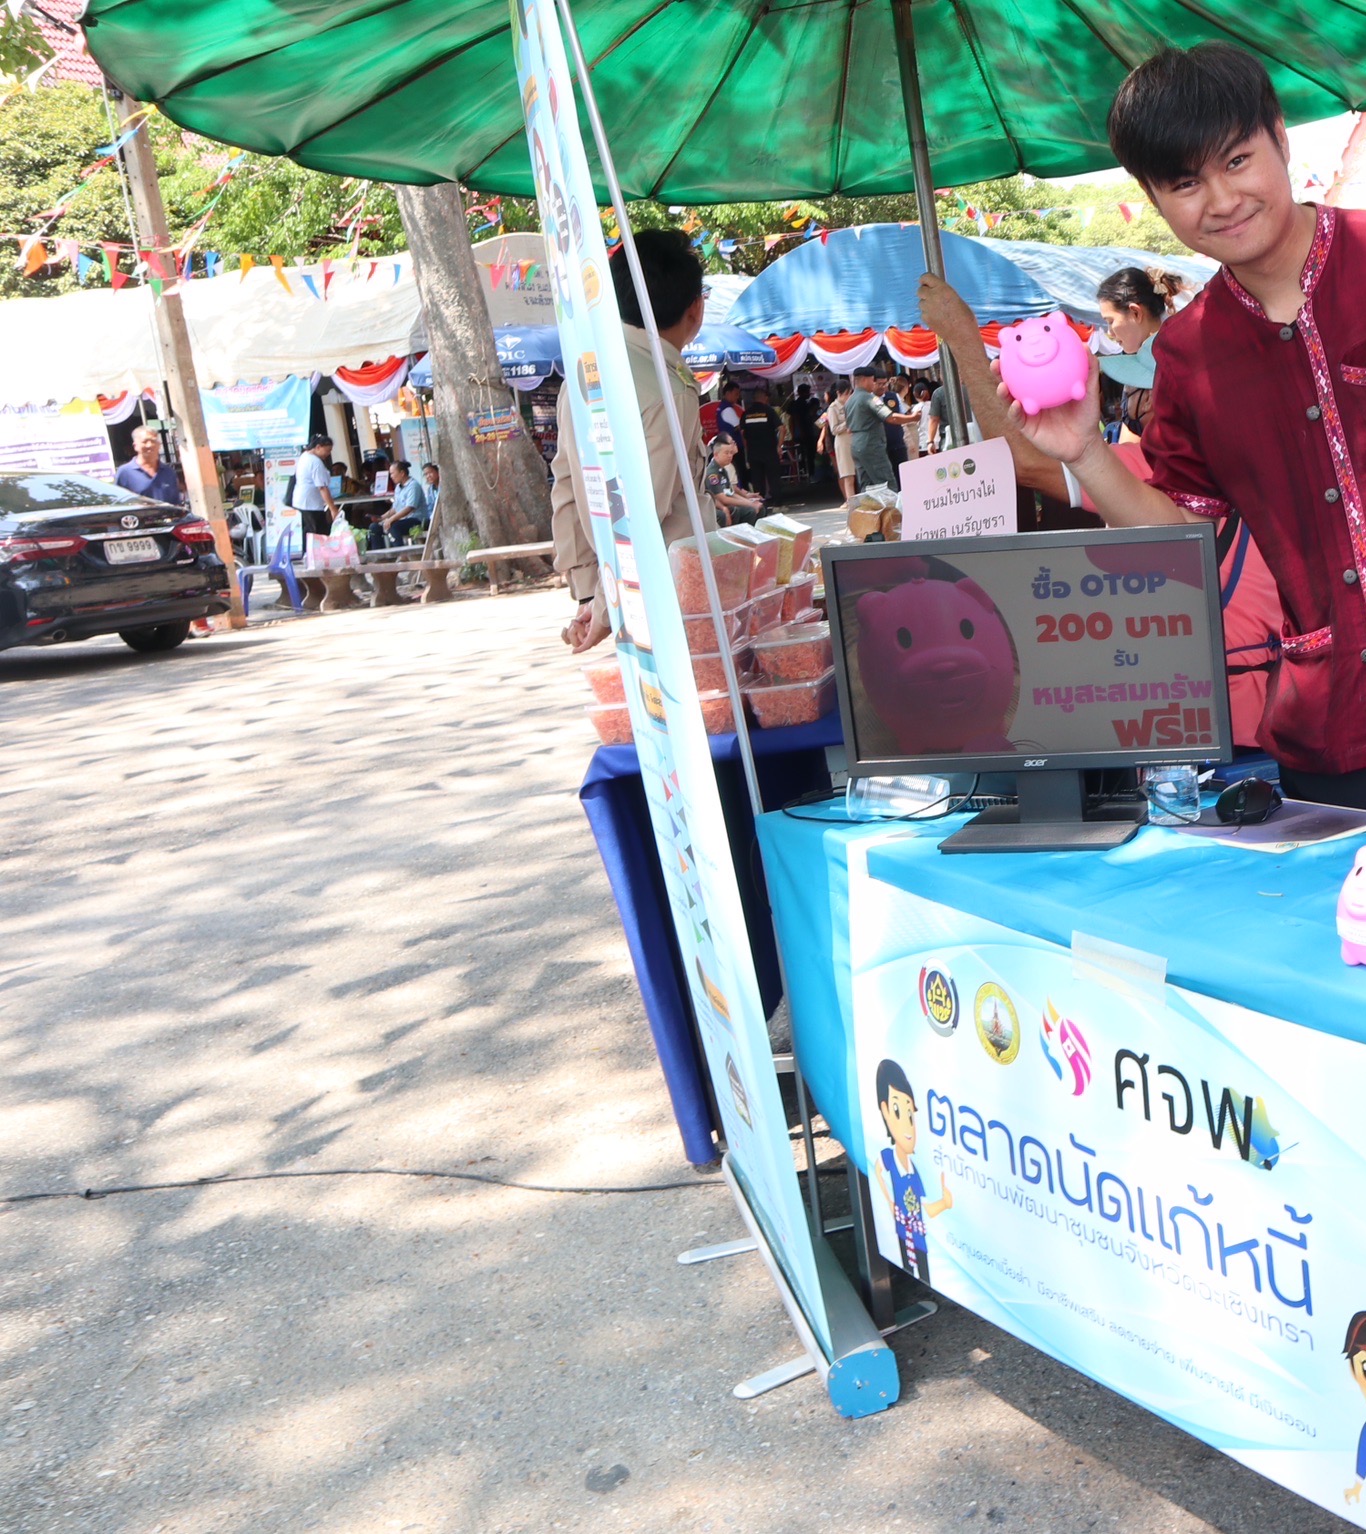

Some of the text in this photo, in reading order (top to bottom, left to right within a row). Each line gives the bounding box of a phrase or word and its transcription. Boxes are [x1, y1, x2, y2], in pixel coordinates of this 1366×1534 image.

[510, 364, 536, 376] 1186
[923, 478, 996, 511] ขนมไข่บางไผ่
[126, 540, 152, 553] 9999
[1031, 566, 1167, 600] ซื้อ OTOP
[1035, 611, 1193, 643] 200 บาท
[1113, 649, 1139, 667] รับ
[1023, 757, 1048, 768] acer
[1113, 1046, 1256, 1163] ศจพ
[926, 1088, 1313, 1317] ตลาดนัดแก้หนี้
